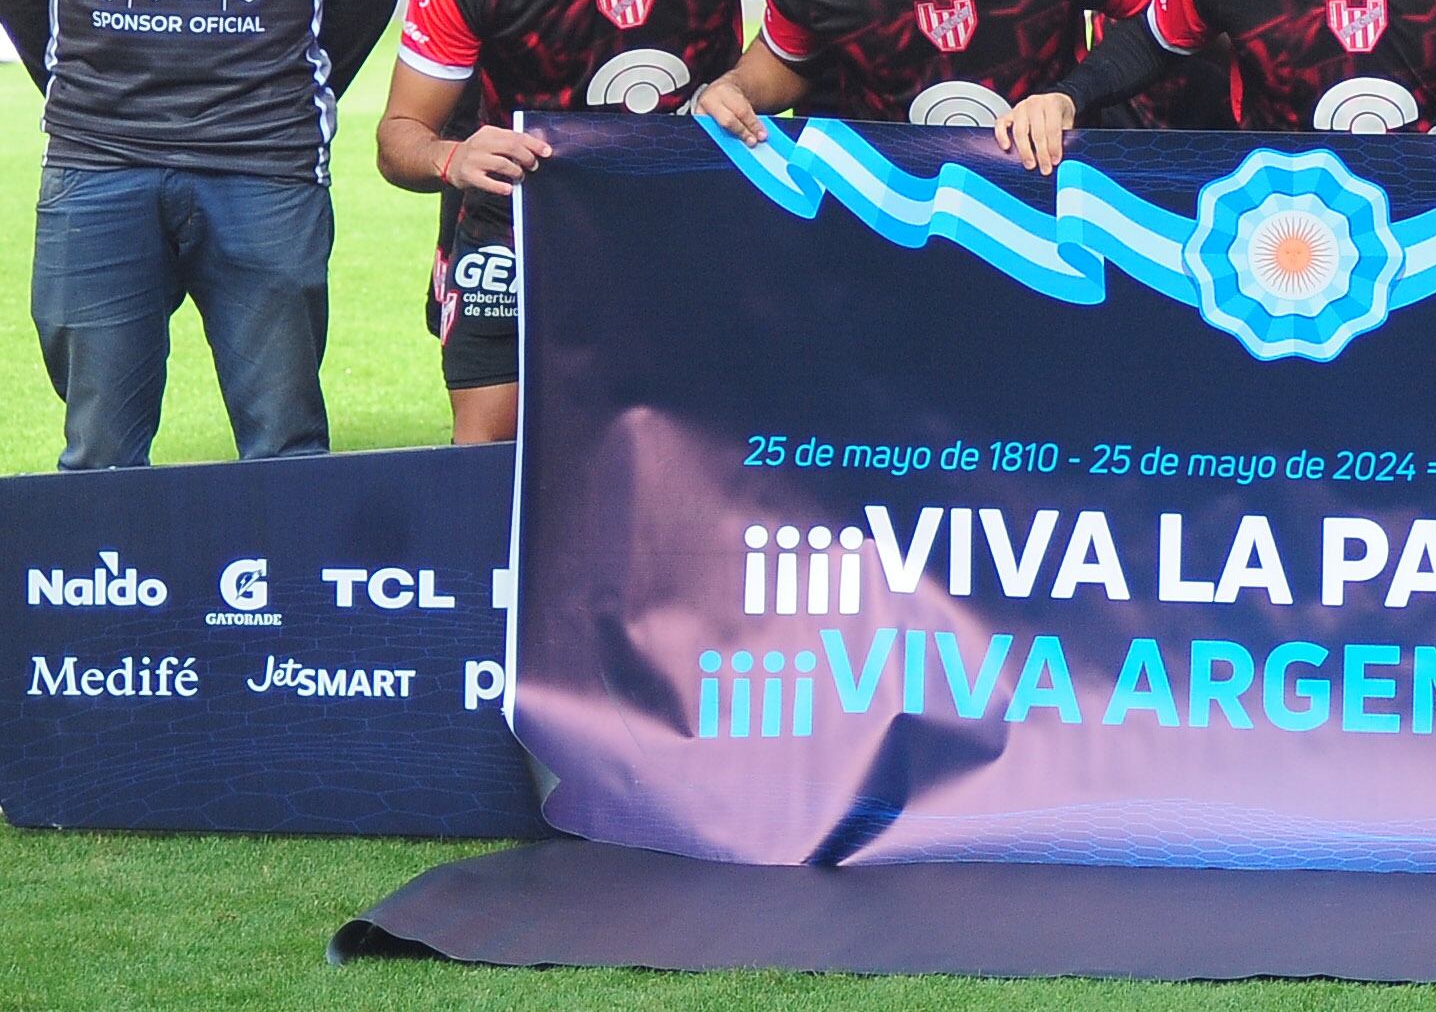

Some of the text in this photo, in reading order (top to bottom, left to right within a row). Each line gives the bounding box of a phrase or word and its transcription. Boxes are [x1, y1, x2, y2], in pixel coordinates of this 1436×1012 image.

[92, 10, 267, 35] SPONSOR OFICIAL
[464, 303, 481, 317] de
[743, 435, 787, 466] 25
[794, 436, 835, 467] de
[842, 445, 932, 476] mayo
[940, 440, 980, 471] de
[990, 441, 1059, 473] 1810
[1089, 443, 1132, 475] 25
[1140, 445, 1179, 476] de
[1187, 454, 1277, 485] mayo
[1285, 449, 1325, 480] de
[1332, 450, 1416, 482] 2024
[1158, 512, 1294, 605] LA
[27, 566, 169, 607] Naldo
[321, 567, 457, 609] TCL
[204, 613, 283, 626] GATORADE
[26, 655, 200, 698] Medifé
[246, 654, 417, 698] JetSMART
